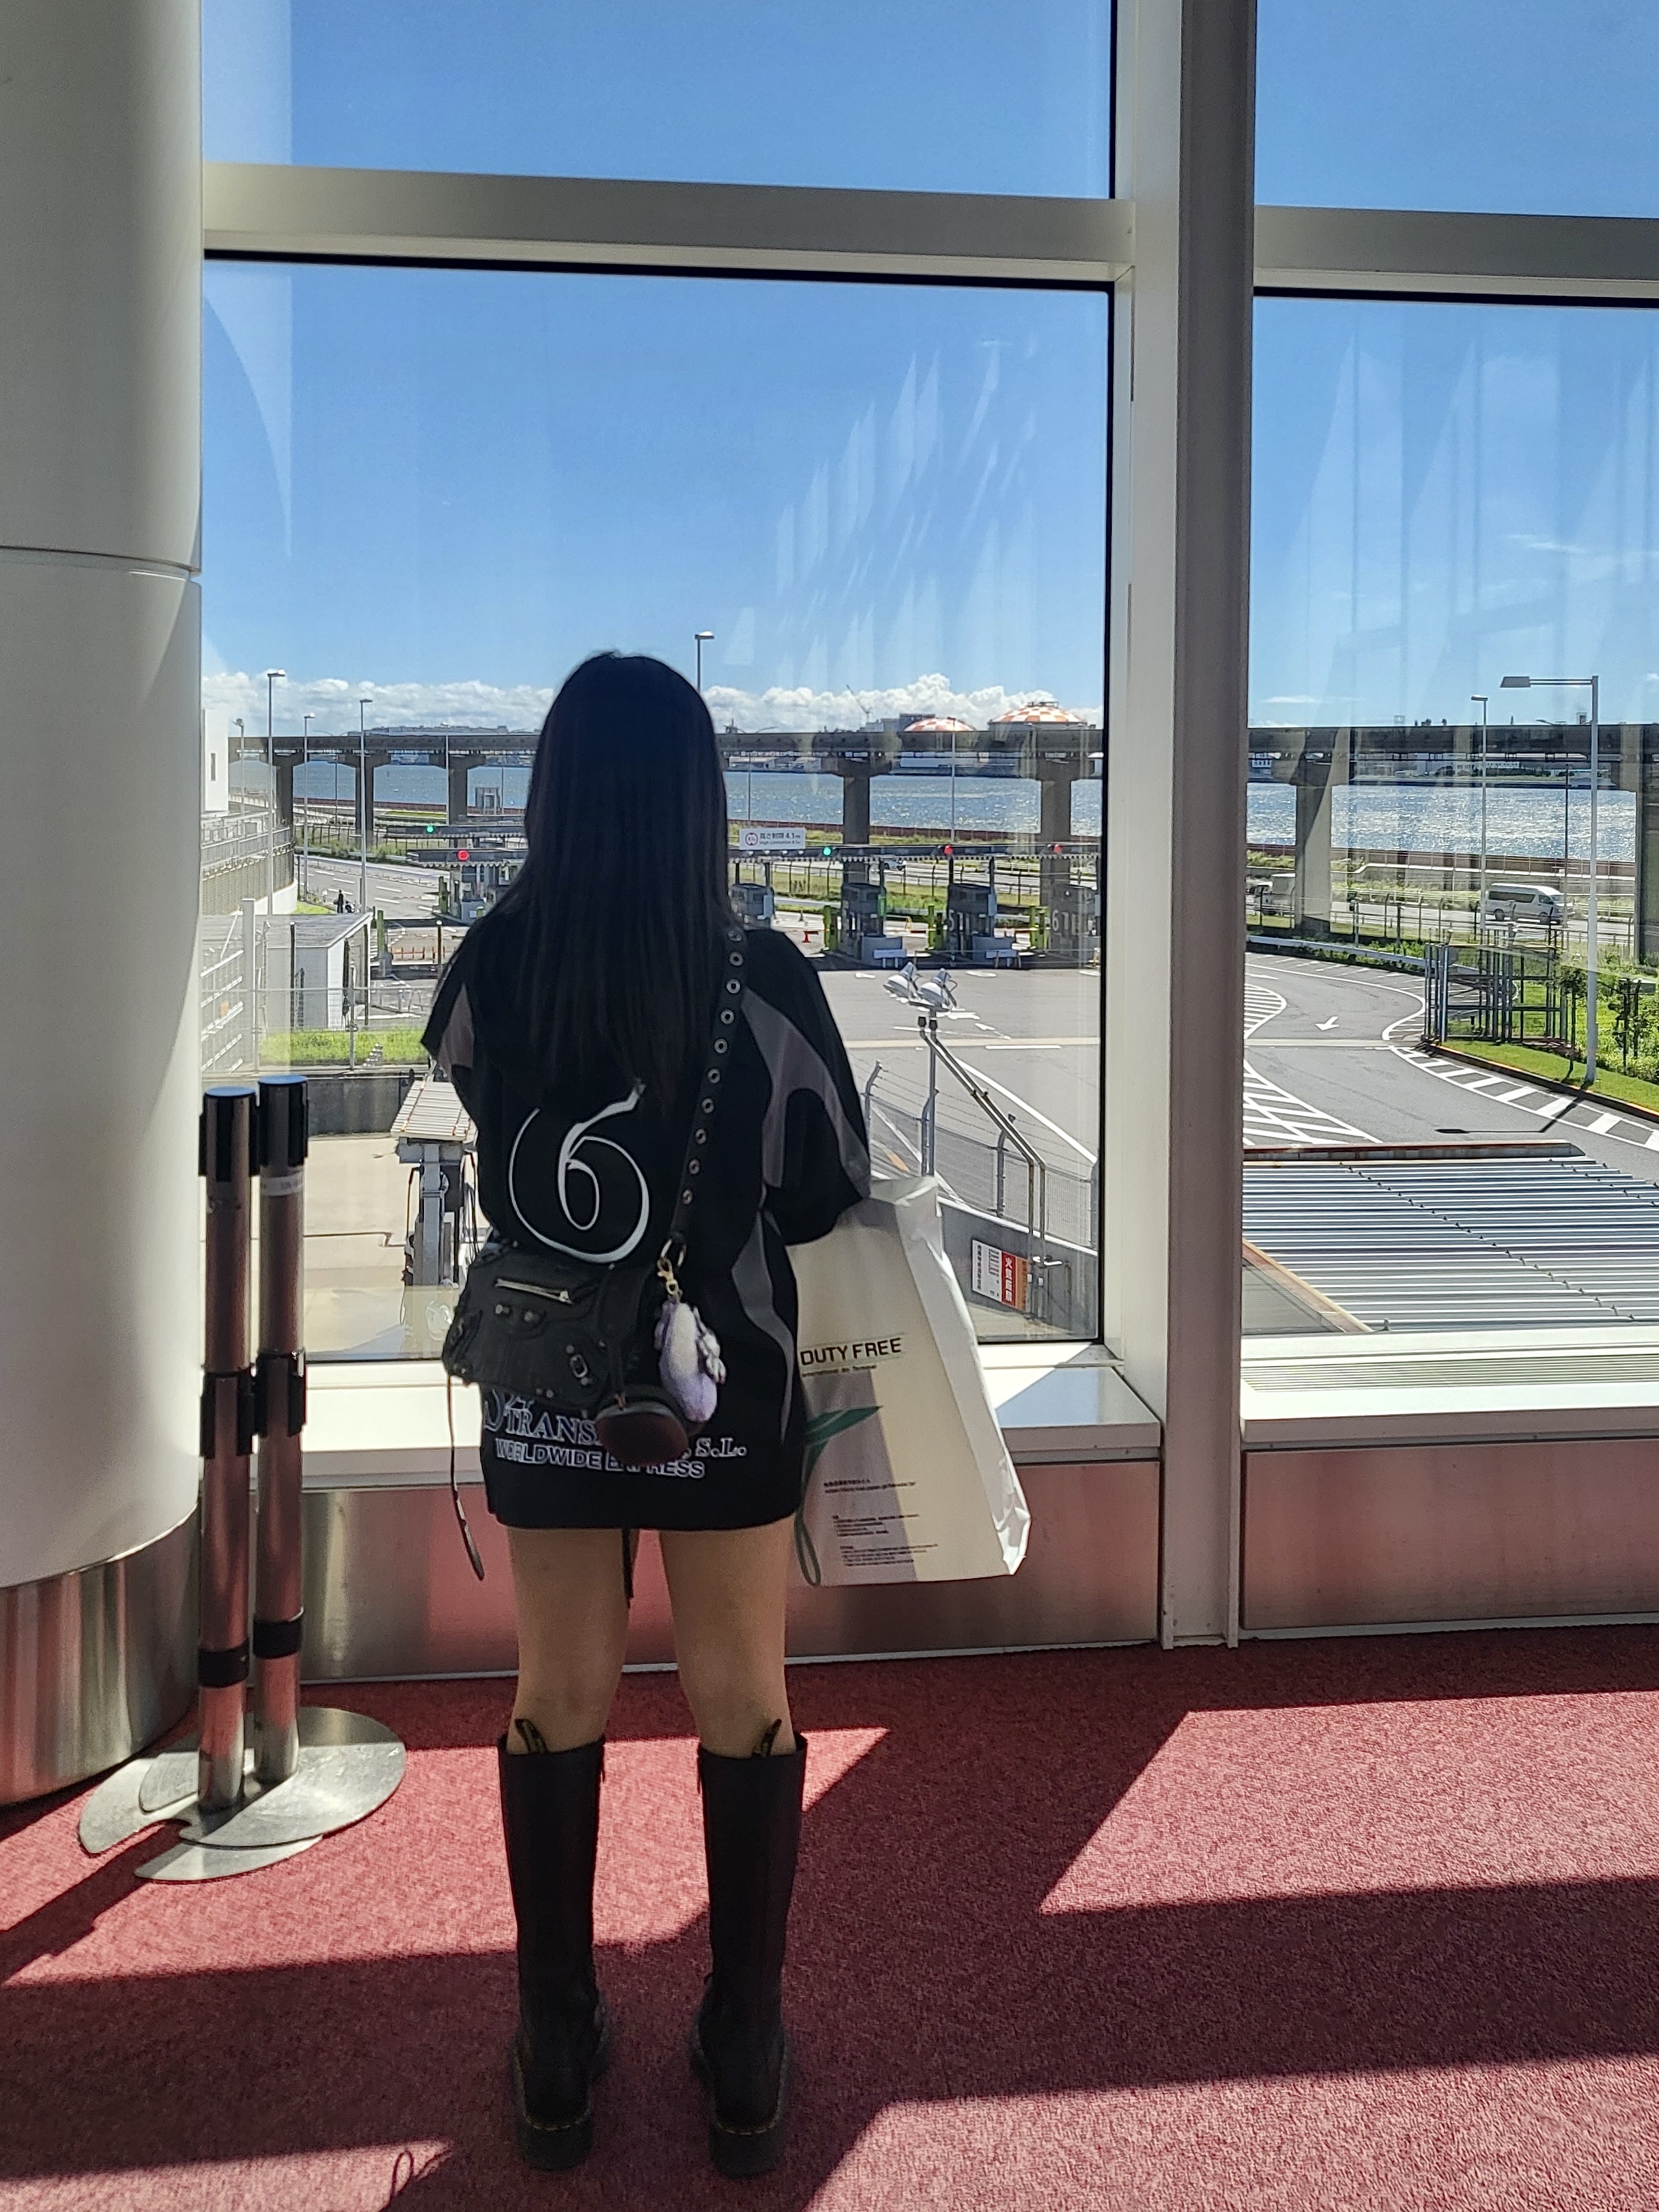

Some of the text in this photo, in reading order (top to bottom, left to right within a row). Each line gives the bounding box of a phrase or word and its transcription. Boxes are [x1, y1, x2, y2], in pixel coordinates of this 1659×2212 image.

[800, 1337, 901, 1365] DUTY FREE
[505, 1407, 603, 1447] TRANS
[695, 1437, 747, 1458] S.L.
[495, 1438, 705, 1479] WORLDWIDE ERESS
